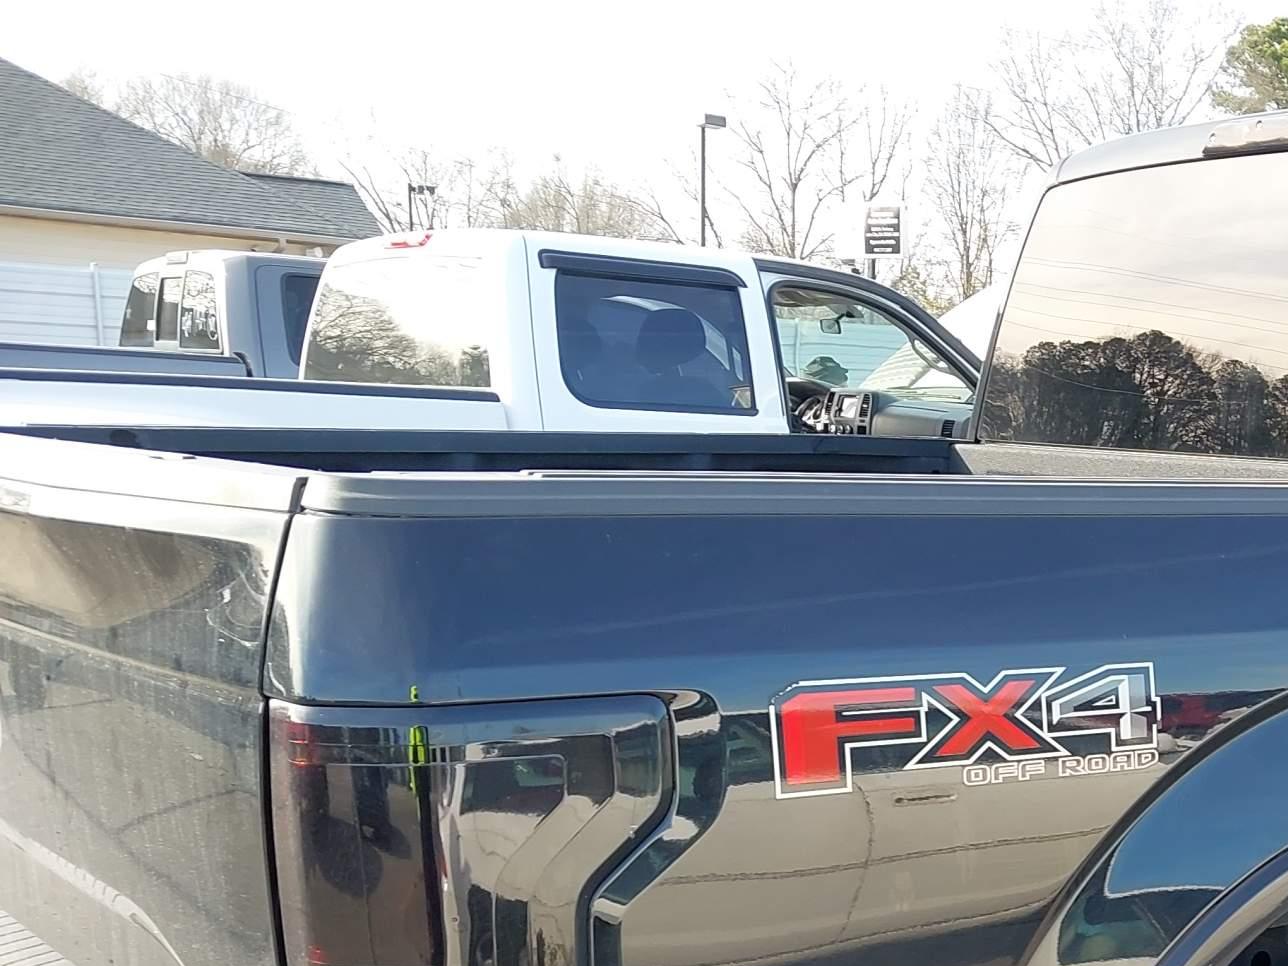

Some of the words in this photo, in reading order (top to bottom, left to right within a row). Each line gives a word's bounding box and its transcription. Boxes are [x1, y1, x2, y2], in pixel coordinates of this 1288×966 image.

[769, 661, 1161, 799] FX4
[963, 760, 1046, 786] OFF
[1058, 749, 1160, 777] ROAD
